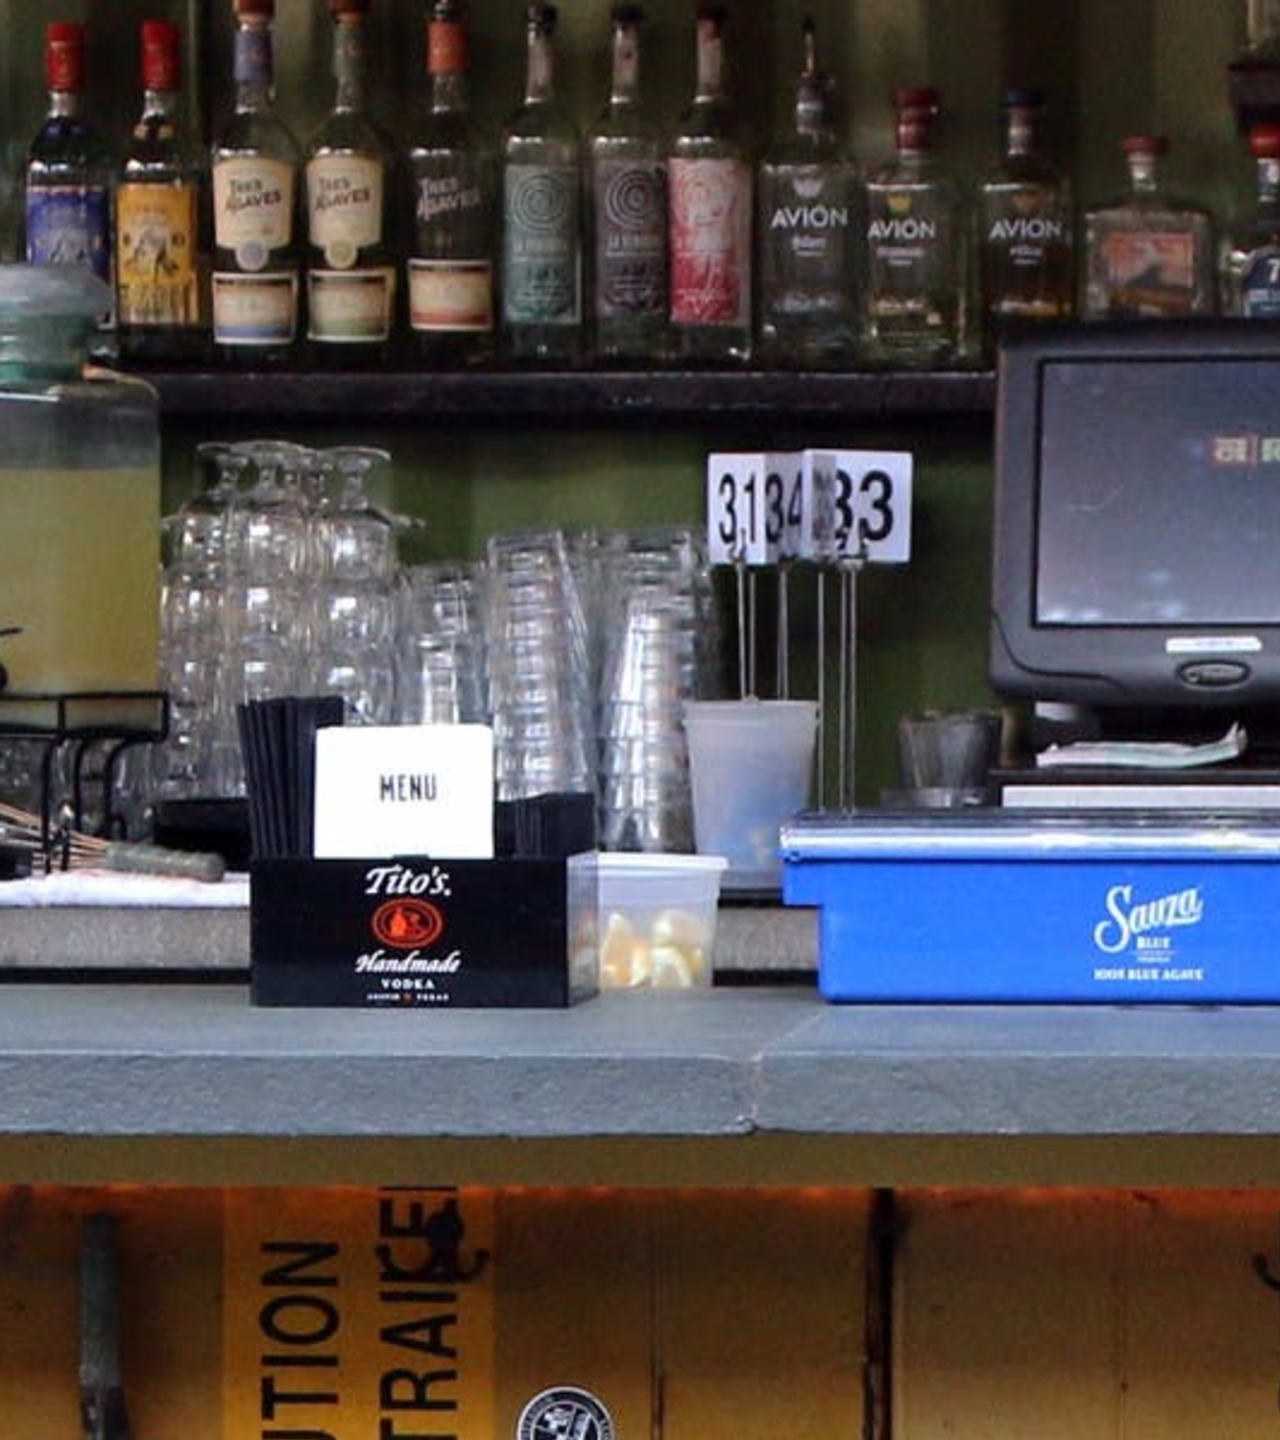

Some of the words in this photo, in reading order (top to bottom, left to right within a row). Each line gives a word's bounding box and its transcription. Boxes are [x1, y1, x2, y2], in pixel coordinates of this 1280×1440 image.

[719, 472, 756, 544] 31
[380, 773, 437, 802] MENU
[1094, 884, 1204, 955] Sauza
[355, 950, 461, 973] Handmade
[381, 978, 435, 990] VODKA
